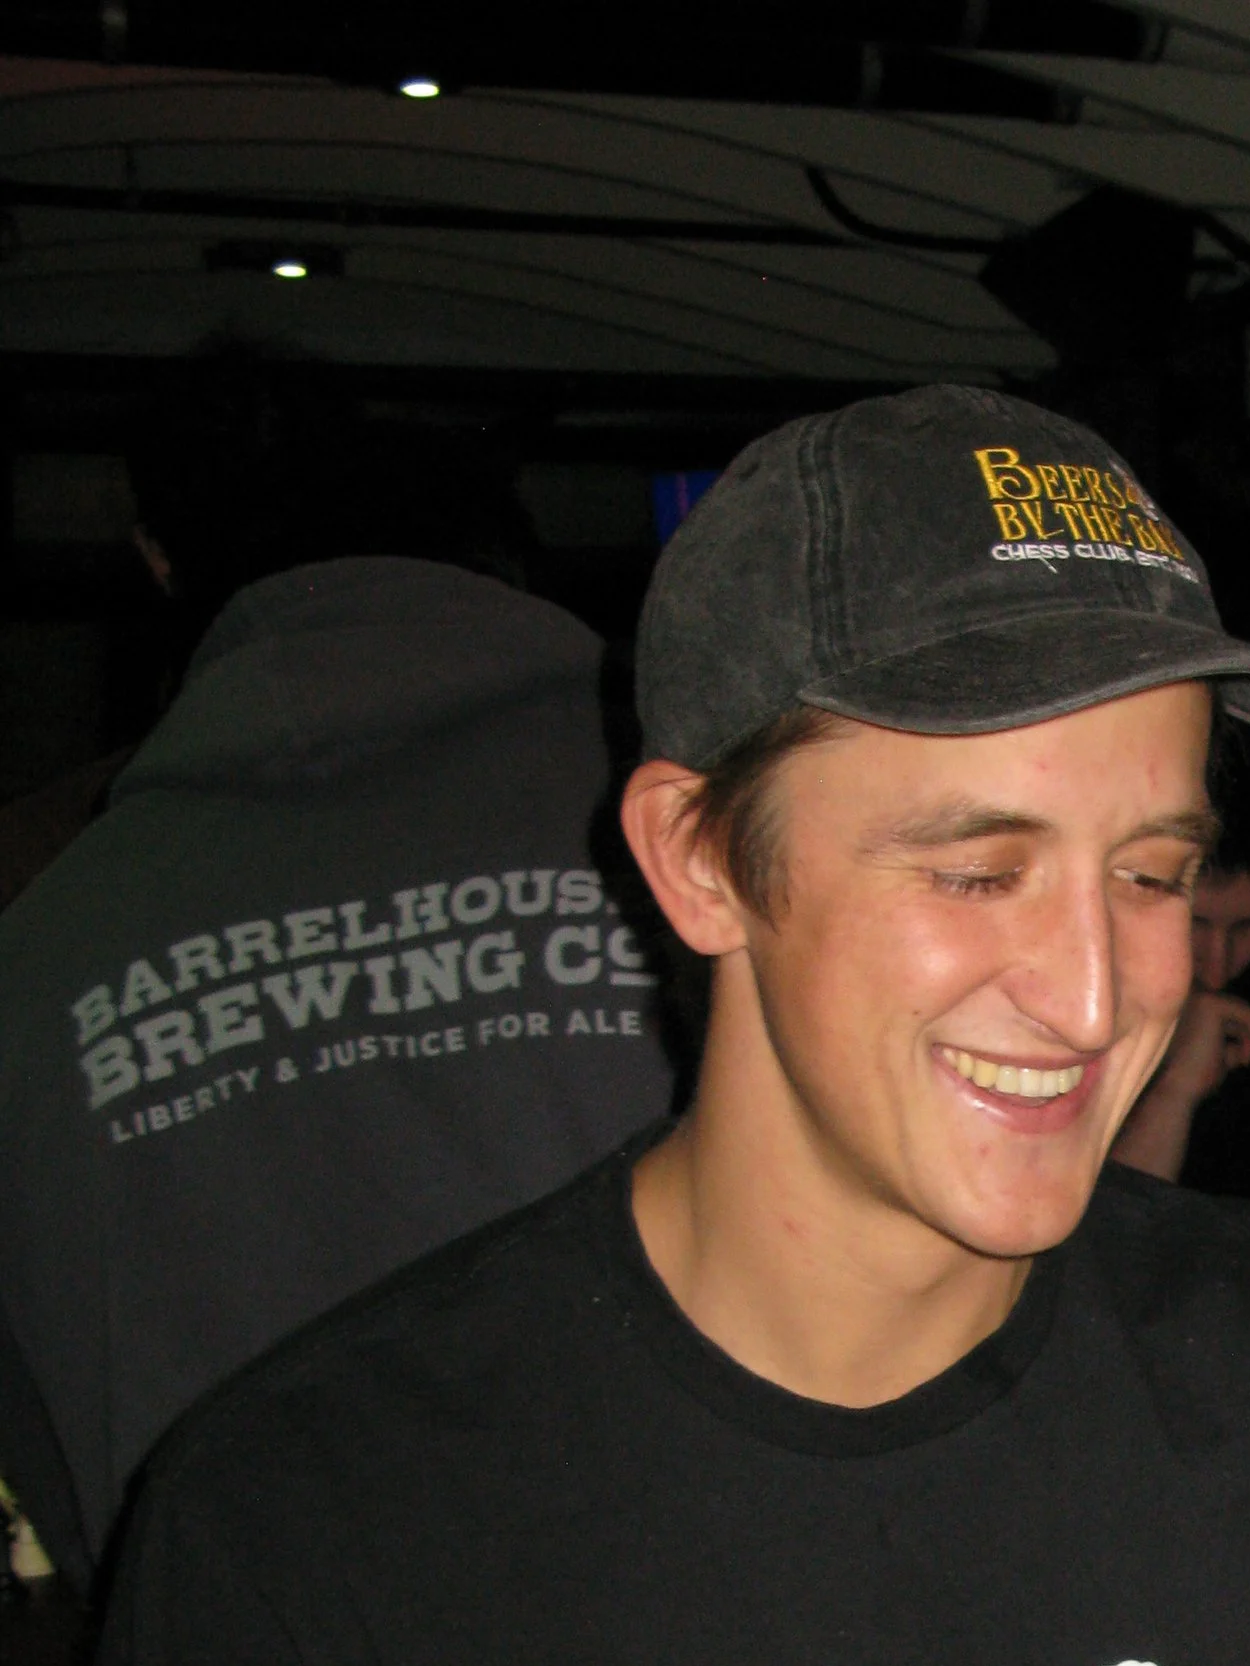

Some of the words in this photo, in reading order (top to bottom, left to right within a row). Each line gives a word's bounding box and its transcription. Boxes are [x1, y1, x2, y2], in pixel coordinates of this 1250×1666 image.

[973, 447, 1128, 510] BEERS
[993, 500, 1046, 541] BY
[1055, 501, 1134, 547] THE
[990, 544, 1070, 562] CHESS
[70, 868, 620, 1045] BARRELHOUS
[79, 930, 525, 1110] BREWING
[111, 1067, 260, 1144] LIBERTY
[274, 1056, 300, 1084] &
[315, 1027, 467, 1074] JUSTICE
[478, 1012, 551, 1046] FOR
[566, 1010, 644, 1037] ALE
